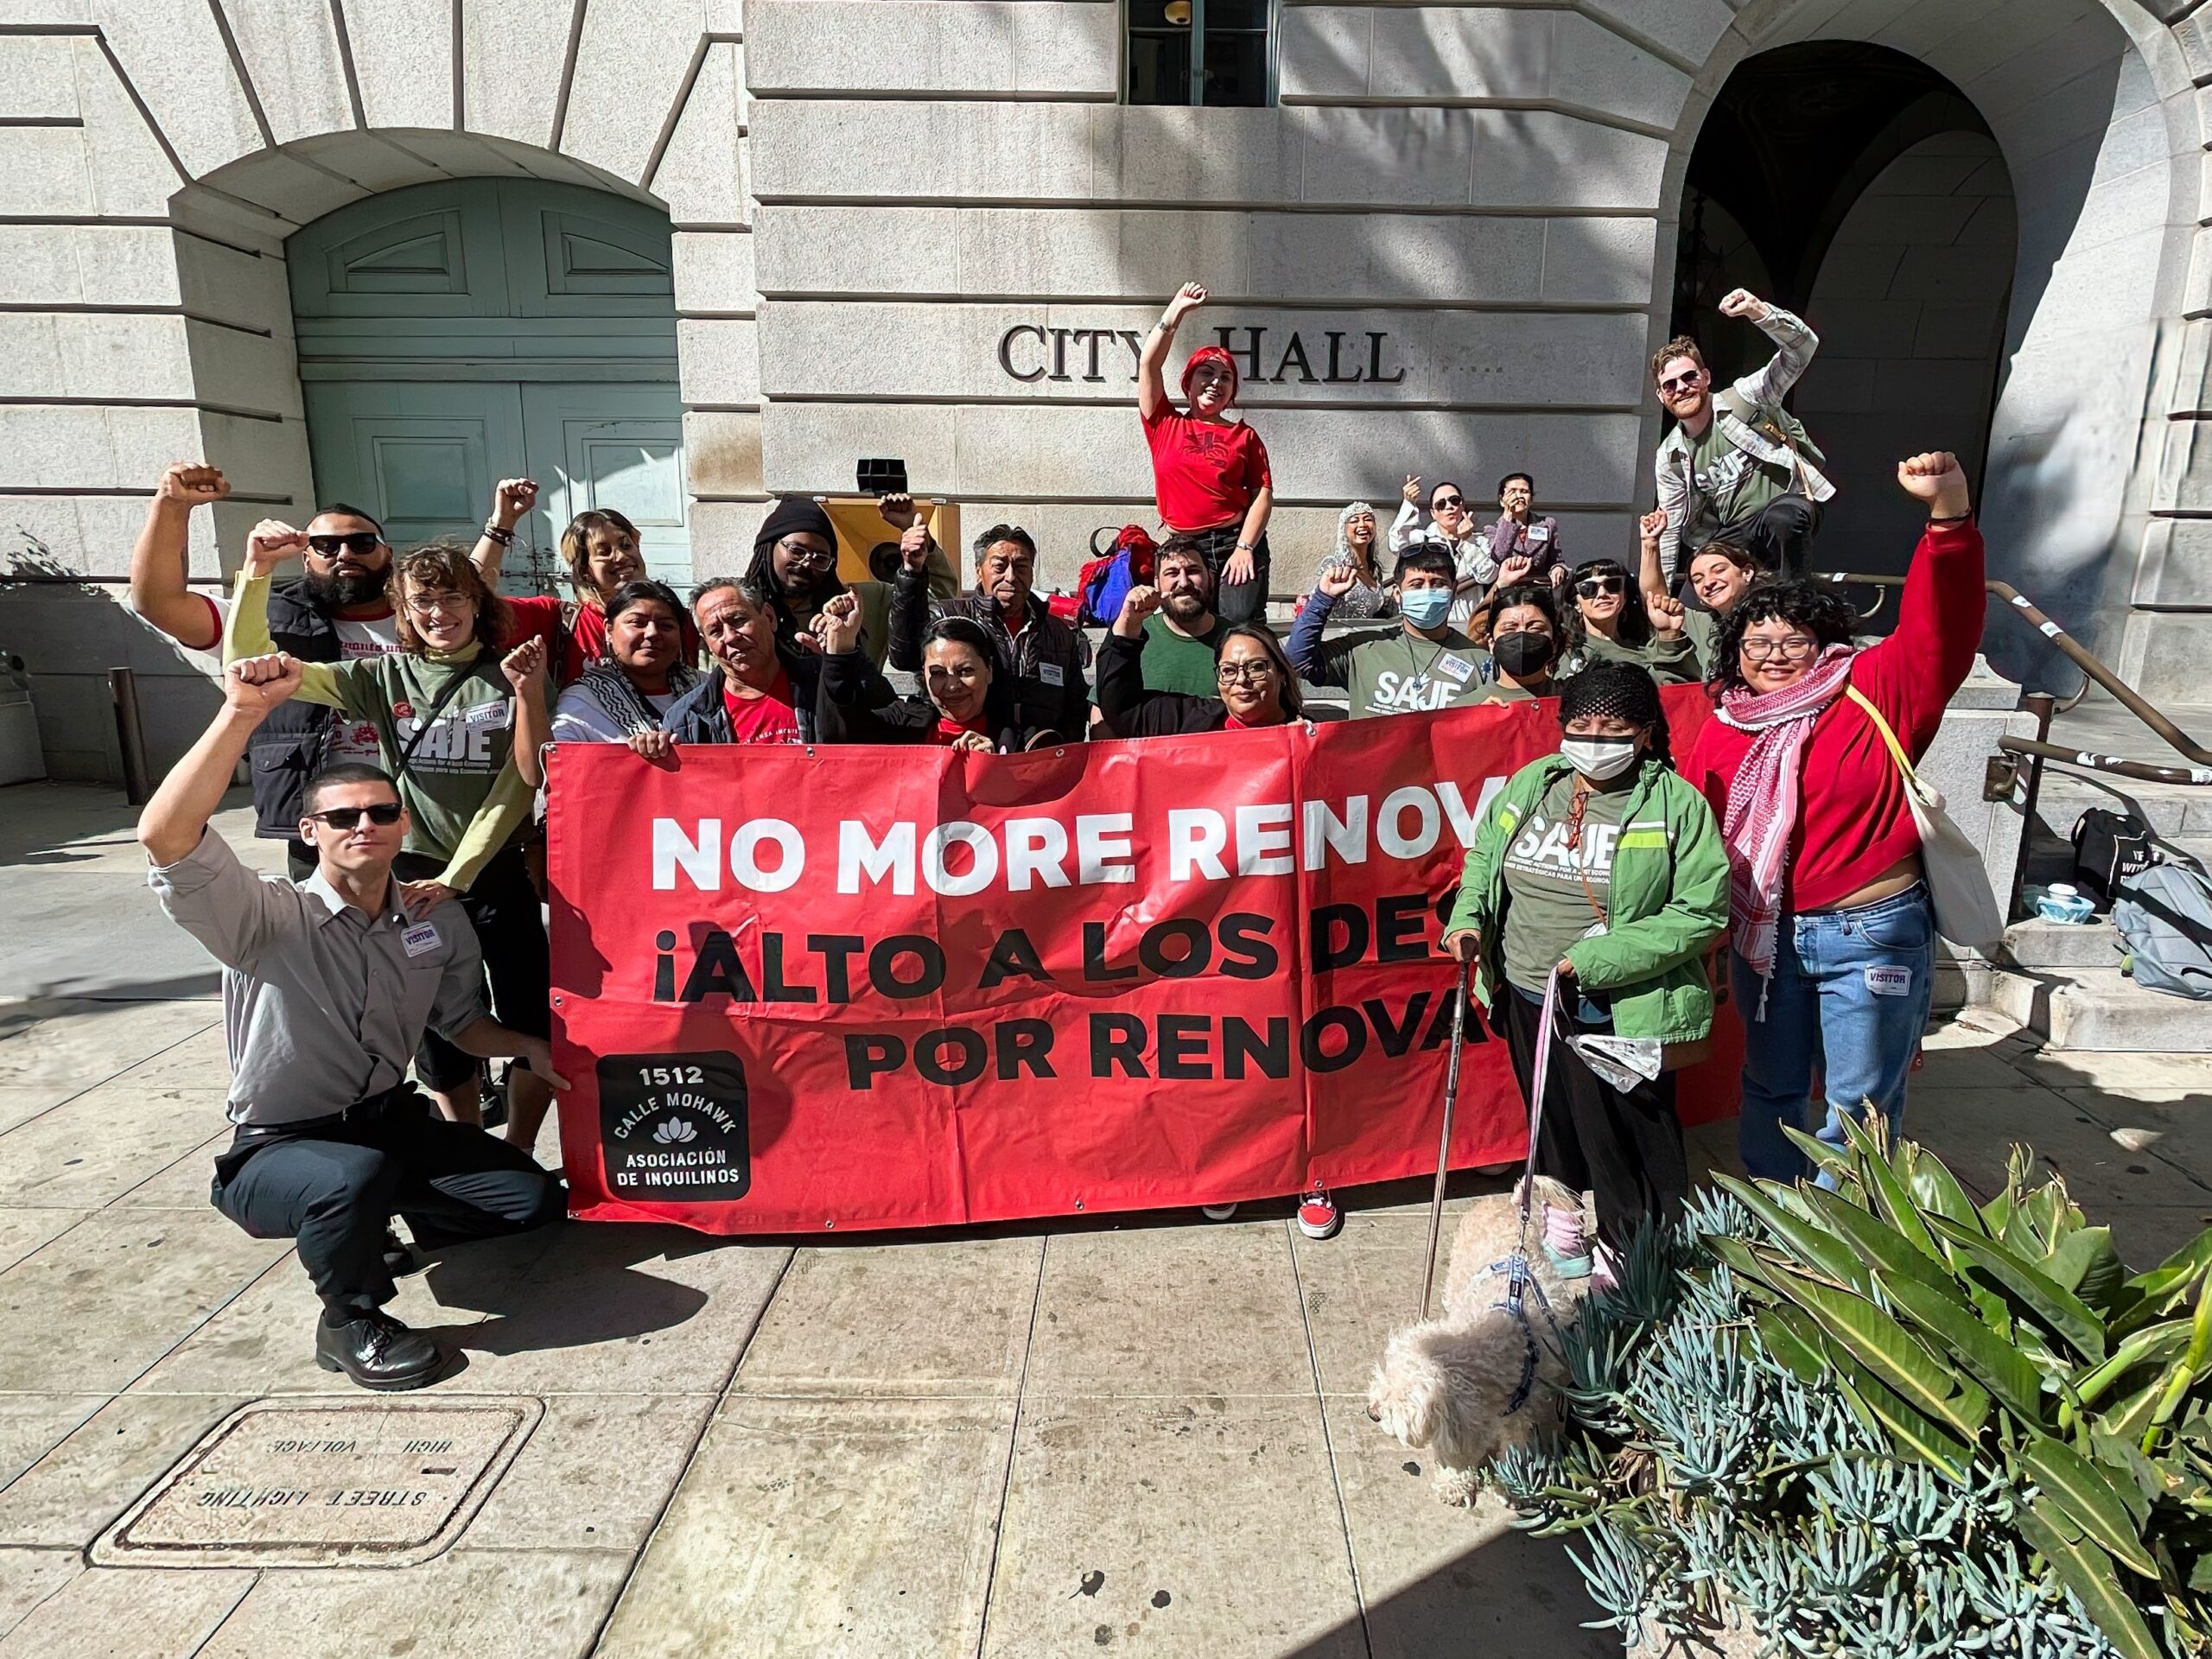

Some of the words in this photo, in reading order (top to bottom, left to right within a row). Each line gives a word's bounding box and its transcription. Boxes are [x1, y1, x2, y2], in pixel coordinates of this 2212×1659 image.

[997, 324, 1144, 383] CITY
[1213, 326, 1407, 384] HALL
[470, 709, 505, 723] VISITOR
[652, 817, 805, 893] NO
[836, 812, 1135, 896] MORE
[405, 930, 435, 944] VISITOR
[653, 930, 946, 1003] ¡ALTO
[977, 928, 1054, 989] A
[1082, 912, 1279, 982] LOS
[1870, 972, 1905, 984] VISITOR
[843, 1017, 1058, 1090] POR
[1089, 987, 1506, 1081] RENOVA
[639, 1066, 703, 1086] 1512
[614, 1096, 659, 1139] CALLE
[667, 1092, 736, 1134] MOHAWK
[626, 1147, 726, 1167] ASOCIACIÓN
[617, 1173, 639, 1186] DE
[645, 1168, 739, 1186] INQUILINOS
[274, 1440, 357, 1453] VOLTAGE
[403, 1440, 452, 1453] HIGH
[196, 1487, 309, 1508] LIGHTING
[326, 1491, 427, 1506] STREET
